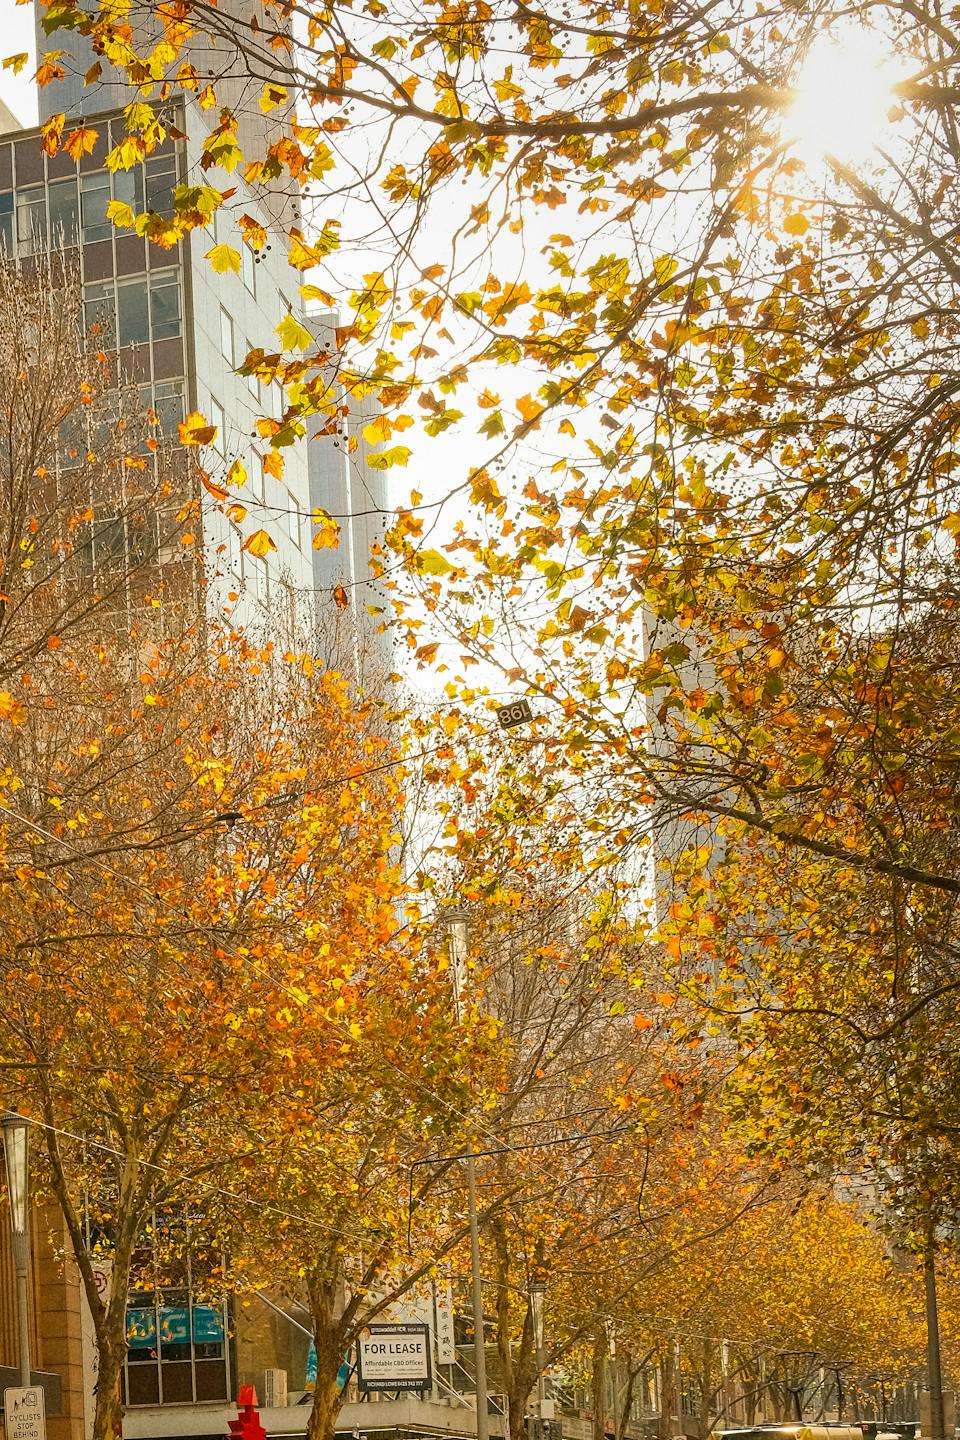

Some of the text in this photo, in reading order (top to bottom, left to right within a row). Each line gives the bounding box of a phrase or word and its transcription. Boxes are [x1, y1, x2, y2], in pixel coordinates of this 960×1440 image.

[364, 1343, 422, 1354] FOR LEASE
[9, 1413, 41, 1422] CYCLISTS
[16, 1422, 34, 1430] STOP
[13, 1430, 39, 1439] BEHIND
